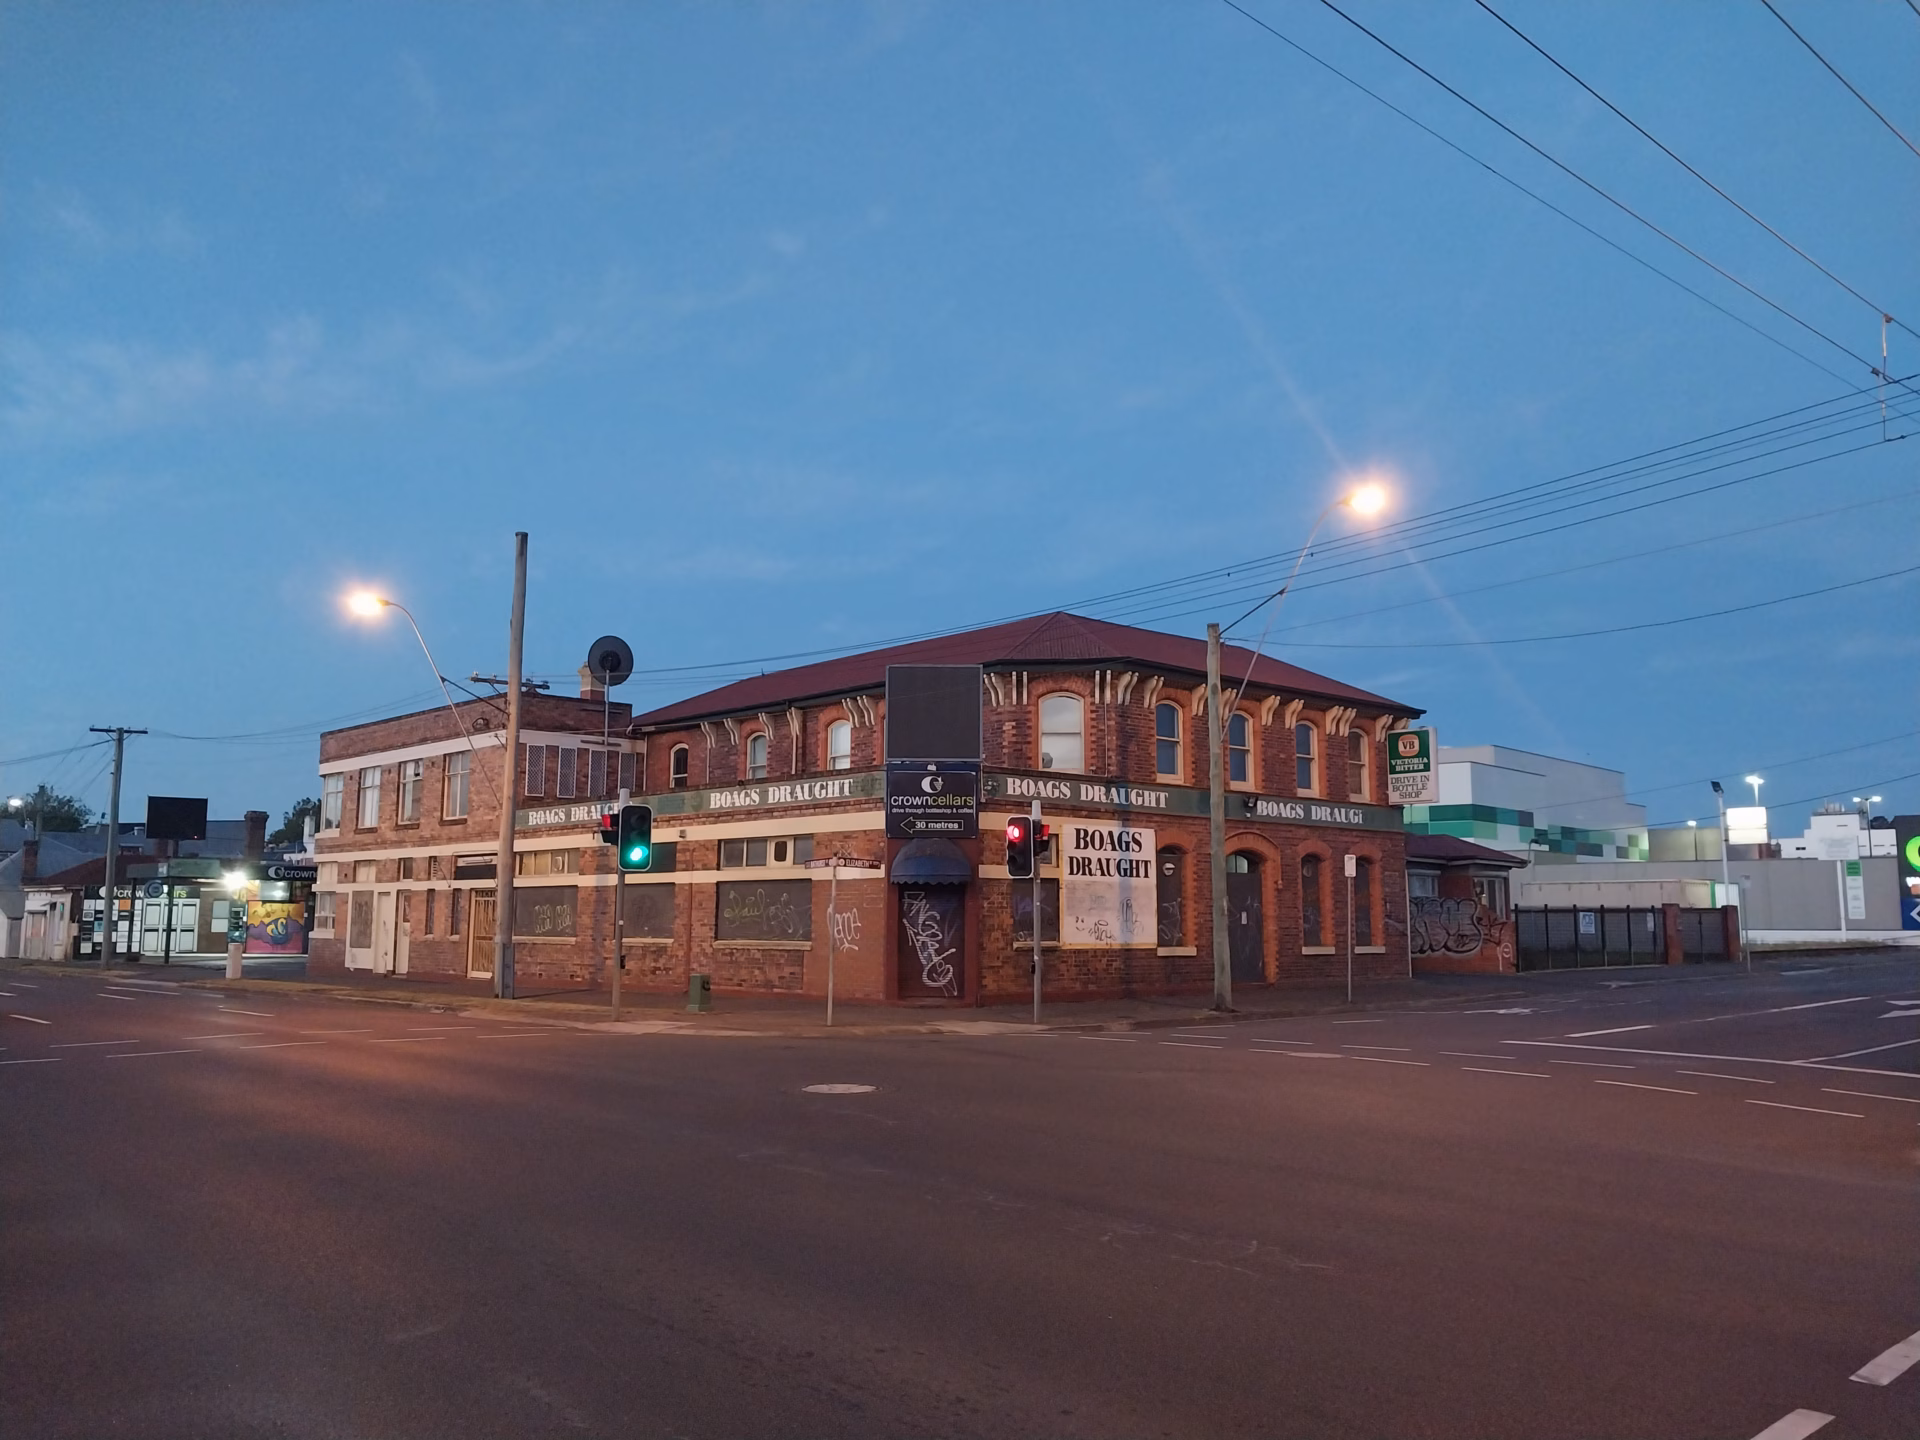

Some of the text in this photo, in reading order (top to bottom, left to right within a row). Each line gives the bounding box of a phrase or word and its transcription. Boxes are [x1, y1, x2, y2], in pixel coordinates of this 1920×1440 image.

[1401, 740, 1416, 750] VB
[1390, 757, 1428, 766] VICTORIA
[1395, 764, 1424, 772] BITTER
[1390, 774, 1430, 785] DRIVE IN
[1006, 777, 1168, 808] BOAGS DRAUGHT
[1392, 783, 1428, 792] BOTTLE
[709, 779, 853, 809] BOAGS DRAUGHT
[890, 793, 974, 806] crowncellars
[1399, 791, 1422, 799] SHOP
[1256, 800, 1305, 820] BOAGS
[528, 808, 566, 825] BOAGS
[915, 821, 959, 829] 30 metres
[1074, 828, 1143, 853] BOAGS
[1068, 856, 1151, 879] DRAUGHT
[284, 870, 317, 878] crown
